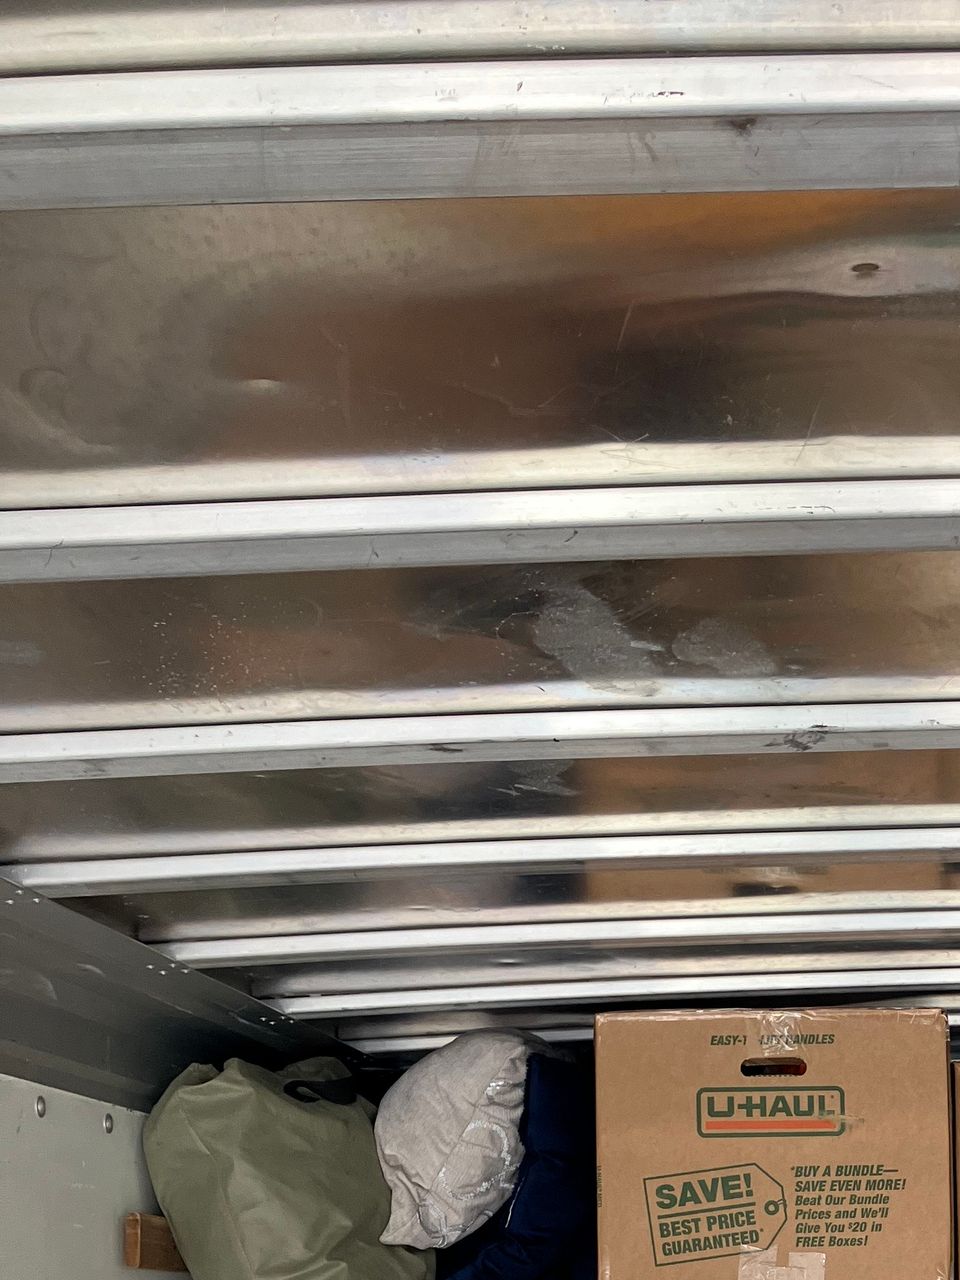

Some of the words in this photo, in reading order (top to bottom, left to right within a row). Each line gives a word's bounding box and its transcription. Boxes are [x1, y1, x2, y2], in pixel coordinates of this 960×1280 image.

[707, 1095, 835, 1117] U-HAUL
[822, 1165, 831, 1177] A
[656, 1173, 753, 1209] SAVE!
[795, 1180, 826, 1192] SAVE
[830, 1180, 861, 1192] EVEN
[865, 1179, 906, 1191] MORE!
[795, 1195, 822, 1206] Beat
[825, 1195, 846, 1205] Our
[849, 1194, 889, 1205] Bundle
[795, 1209, 831, 1219] Prices
[835, 1208, 857, 1219] and
[861, 1207, 889, 1218] We'll
[659, 1217, 701, 1238] BEST
[706, 1210, 756, 1232] PRICE
[796, 1223, 820, 1233] Give
[825, 1222, 845, 1233] You
[848, 1222, 867, 1232] $20
[871, 1221, 882, 1232] in
[796, 1237, 825, 1247] FREE
[828, 1236, 868, 1247] Boxes!
